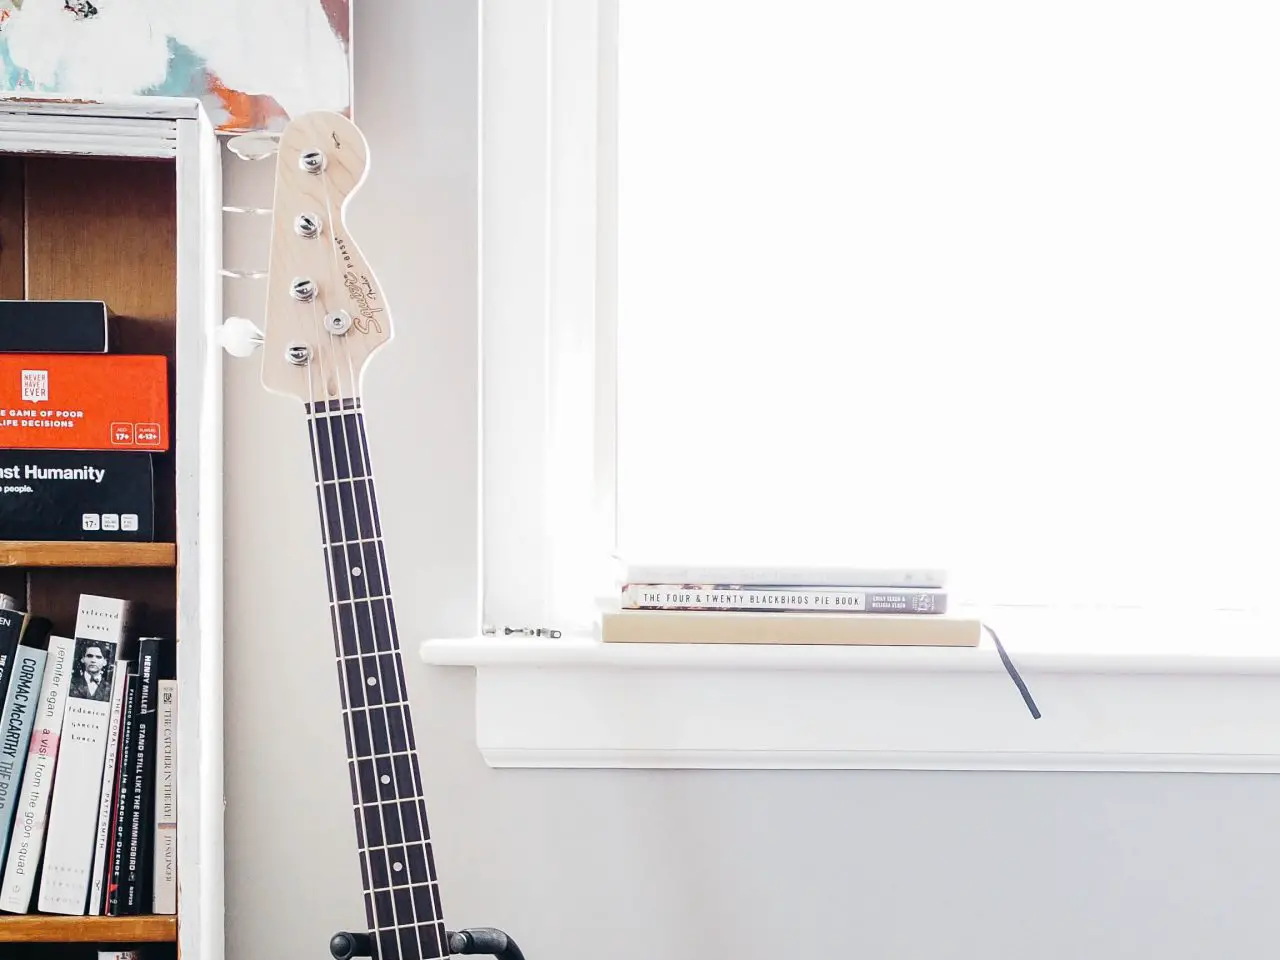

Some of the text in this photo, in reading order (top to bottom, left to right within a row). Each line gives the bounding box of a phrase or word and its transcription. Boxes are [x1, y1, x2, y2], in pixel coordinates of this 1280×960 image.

[24, 388, 46, 397] EVER
[9, 409, 37, 417] GAME
[56, 410, 84, 418] POOR
[22, 420, 74, 428] DECISIONS
[24, 464, 105, 483] Humanity
[4, 485, 34, 494] people.
[643, 593, 860, 606] THE FOUR & TWENTY BLACKBIRDS PIE BOOK
[15, 658, 37, 702] CORMAC
[140, 655, 152, 715] HENRY MILLER
[47, 690, 58, 718] egan
[163, 708, 172, 727] THE
[2, 702, 27, 759] McCARTHY
[38, 738, 49, 761] visit
[33, 763, 46, 789] from
[29, 790, 41, 808] the
[128, 723, 147, 871] STAND STILL LIKE THE HUMMINGBIRD
[24, 810, 35, 839] goon
[99, 822, 107, 850] SMITH
[16, 842, 29, 876] squad
